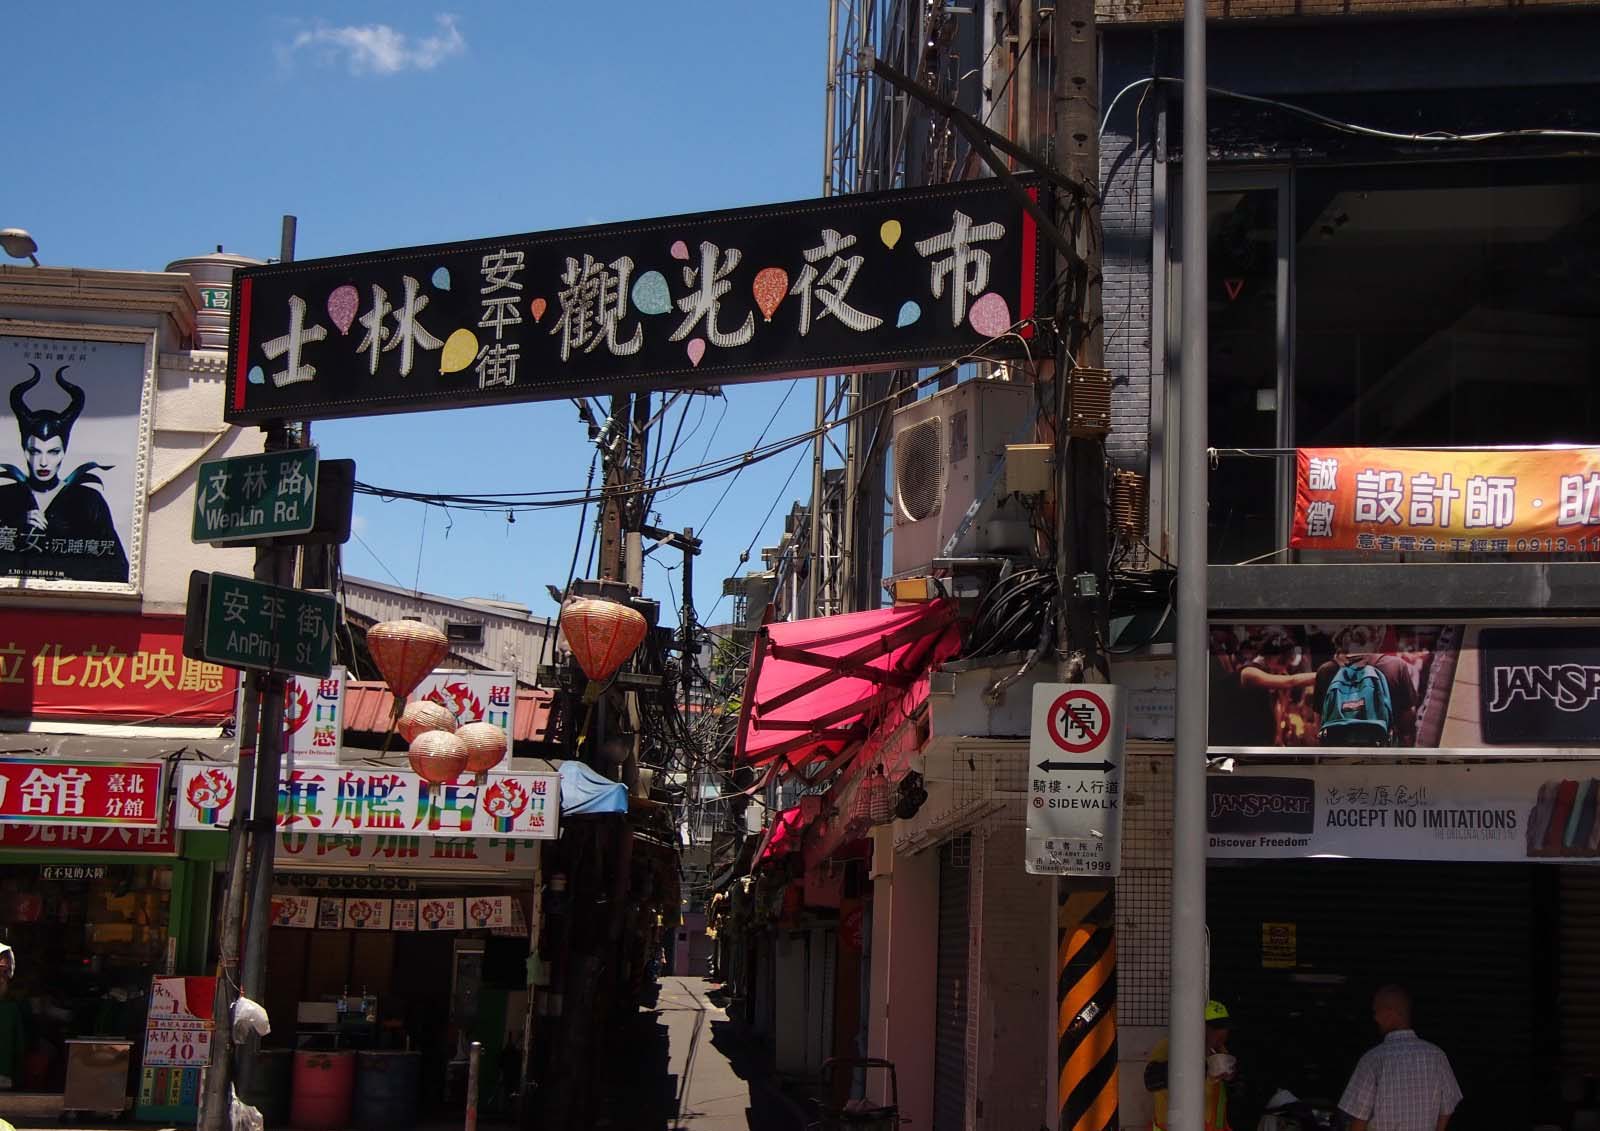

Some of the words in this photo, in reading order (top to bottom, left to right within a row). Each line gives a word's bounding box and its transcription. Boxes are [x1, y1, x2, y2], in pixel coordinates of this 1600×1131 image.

[261, 274, 444, 388] 士林
[475, 248, 526, 389] 安平街
[207, 461, 305, 504] 文林路
[1307, 457, 1338, 537] 誠徵
[206, 504, 265, 531] WenLin
[274, 499, 300, 523] Rd.
[223, 588, 322, 638] 安平街
[226, 630, 280, 665] AnPing
[312, 679, 340, 747] 超口感
[488, 685, 511, 728] 超口
[1060, 704, 1096, 739] 停
[107, 773, 144, 794] 臺北
[529, 780, 546, 827] 超口感
[1048, 798, 1118, 809] SIDEWALK
[1326, 808, 1387, 828] ACCEPT
[1394, 809, 1417, 828] NO
[1423, 808, 1517, 830] IMITATIONS
[1209, 837, 1257, 848] Discover
[1260, 837, 1308, 847] Freedom
[1085, 861, 1111, 871] 1999
[165, 1044, 195, 1060] 40
